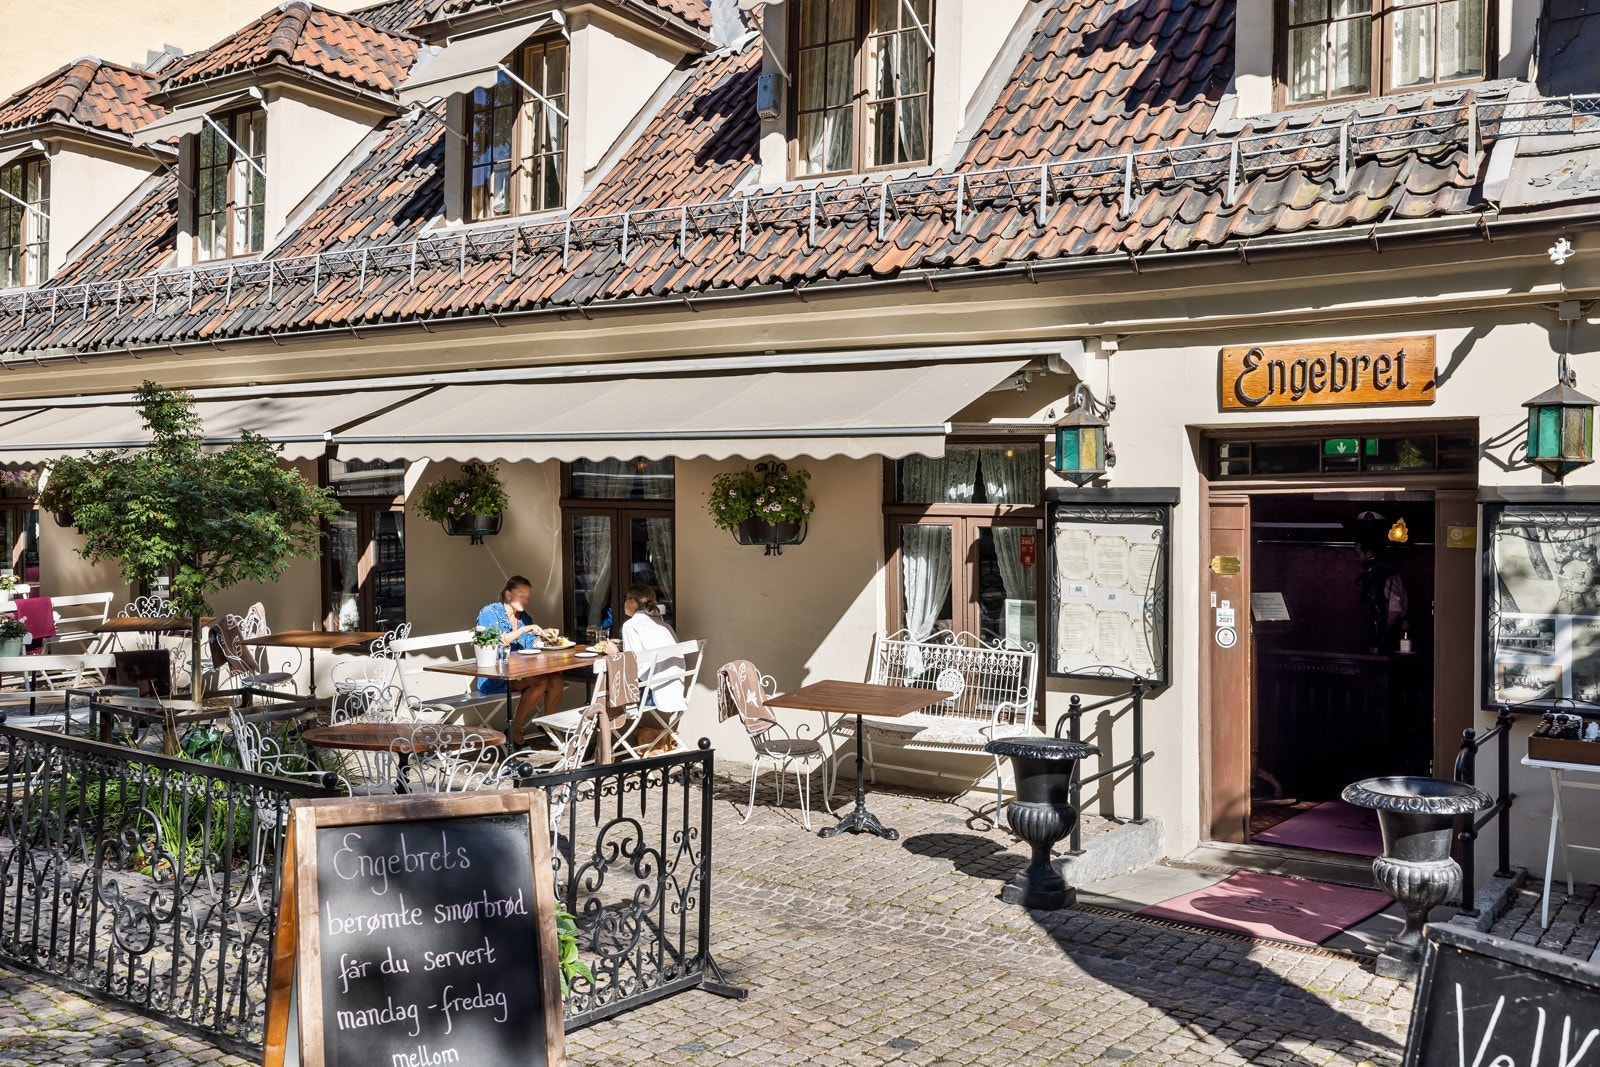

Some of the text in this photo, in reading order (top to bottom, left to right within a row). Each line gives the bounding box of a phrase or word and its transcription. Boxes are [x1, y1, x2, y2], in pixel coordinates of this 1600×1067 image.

[1234, 347, 1409, 407] Engebret
[333, 831, 471, 896] Engebrets
[326, 888, 528, 936] berømte smørbrød
[338, 953, 371, 993] får
[380, 947, 410, 974] du
[336, 997, 420, 1037] mandag
[392, 1045, 460, 1067] mellom
